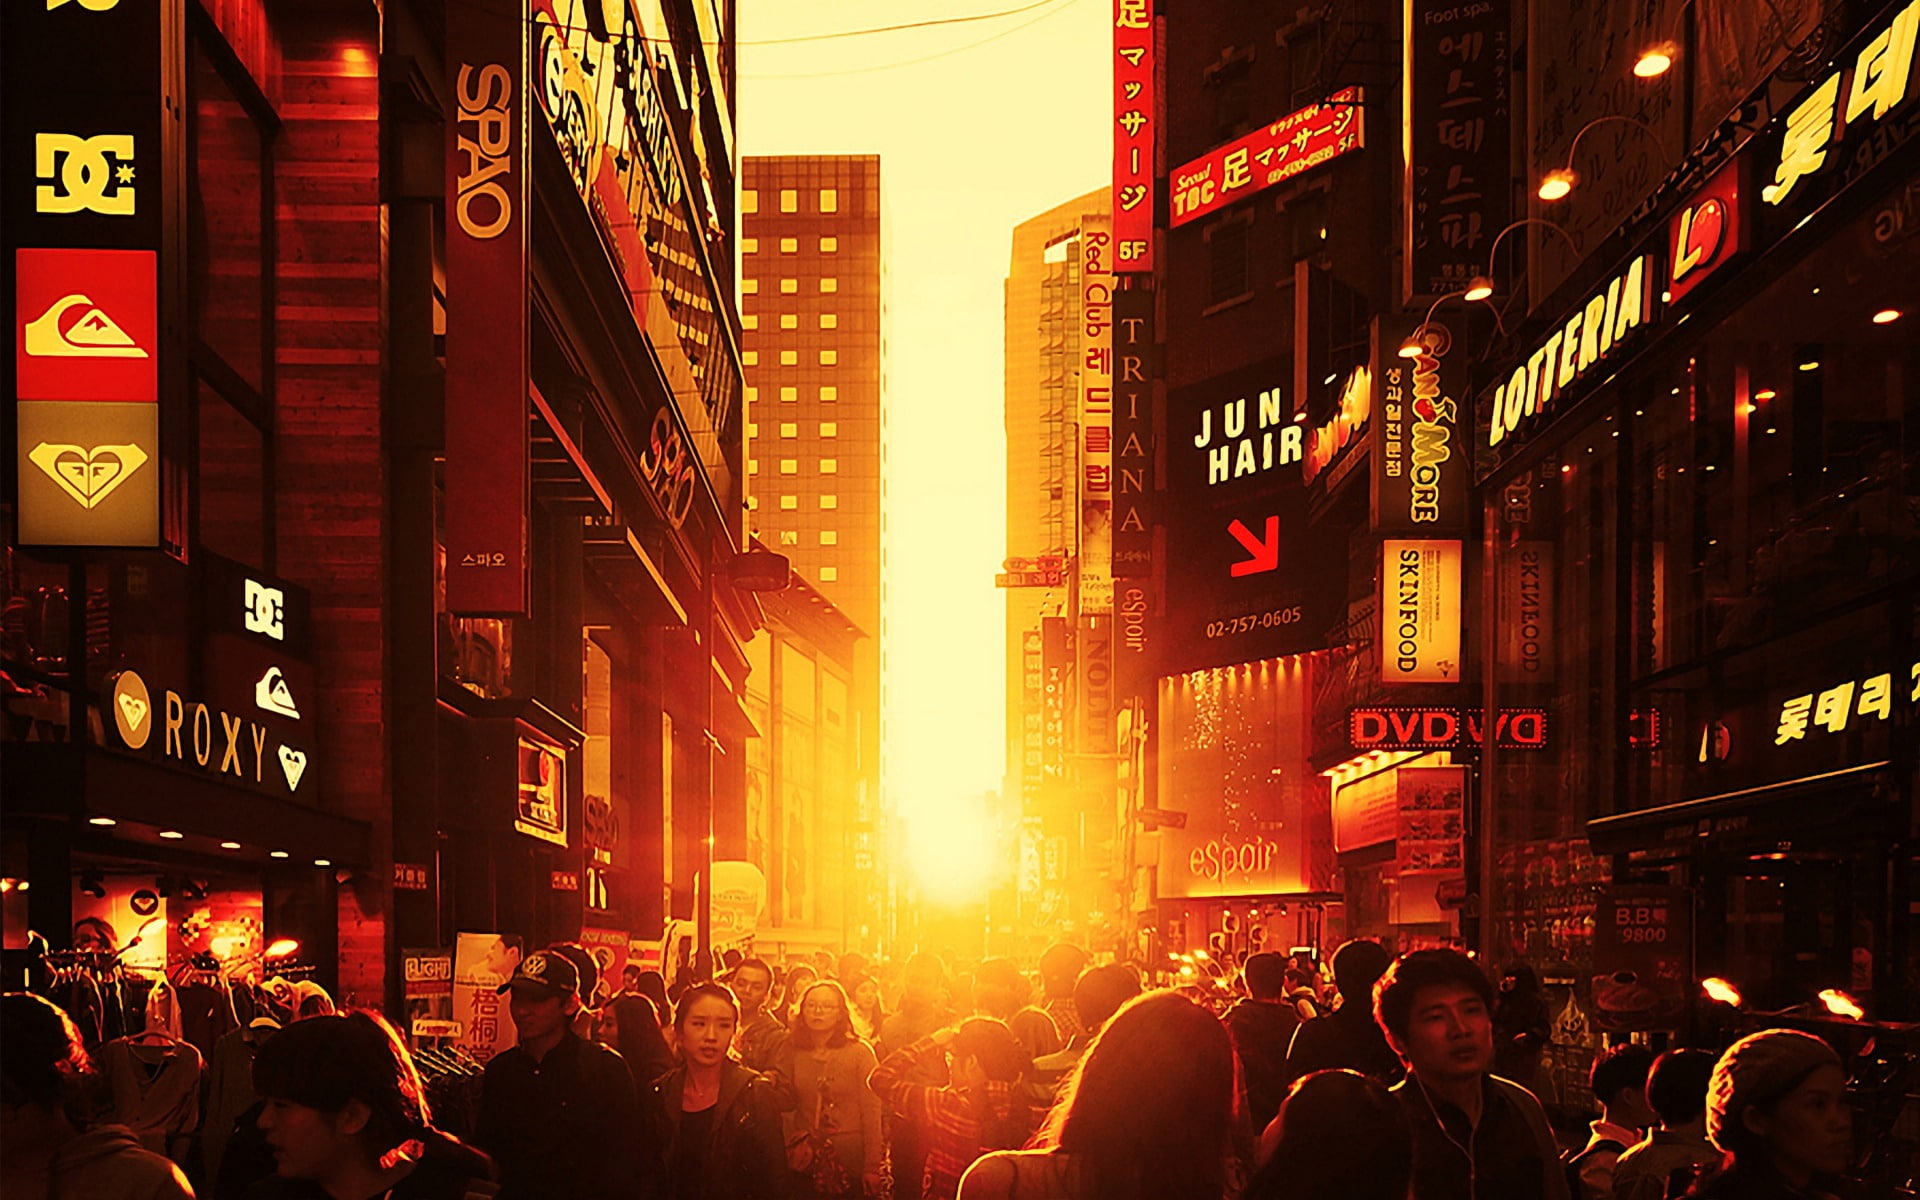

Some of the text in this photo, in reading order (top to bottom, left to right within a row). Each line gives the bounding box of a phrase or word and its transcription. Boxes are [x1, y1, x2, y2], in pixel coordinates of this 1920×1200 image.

[457, 62, 511, 239] SPAO
[1085, 231, 1112, 337] Red Club
[1489, 255, 1644, 447] LOTTERIA
[1085, 347, 1112, 493] 레드클럽
[1120, 318, 1145, 532] TRIANA
[1194, 387, 1281, 448] JUN
[1208, 425, 1303, 486] HAIR
[1386, 367, 1402, 477] 생과일전문점
[1410, 422, 1451, 523] MORE
[461, 553, 507, 568] 스파오
[1120, 589, 1147, 652] espoir
[1206, 606, 1302, 638] 02-757-0605
[1398, 550, 1419, 673] SKINFOOD
[166, 690, 266, 782] ROXY
[1353, 712, 1457, 743] DVD
[1190, 836, 1277, 885] espoir
[1622, 927, 1667, 943] 9800
